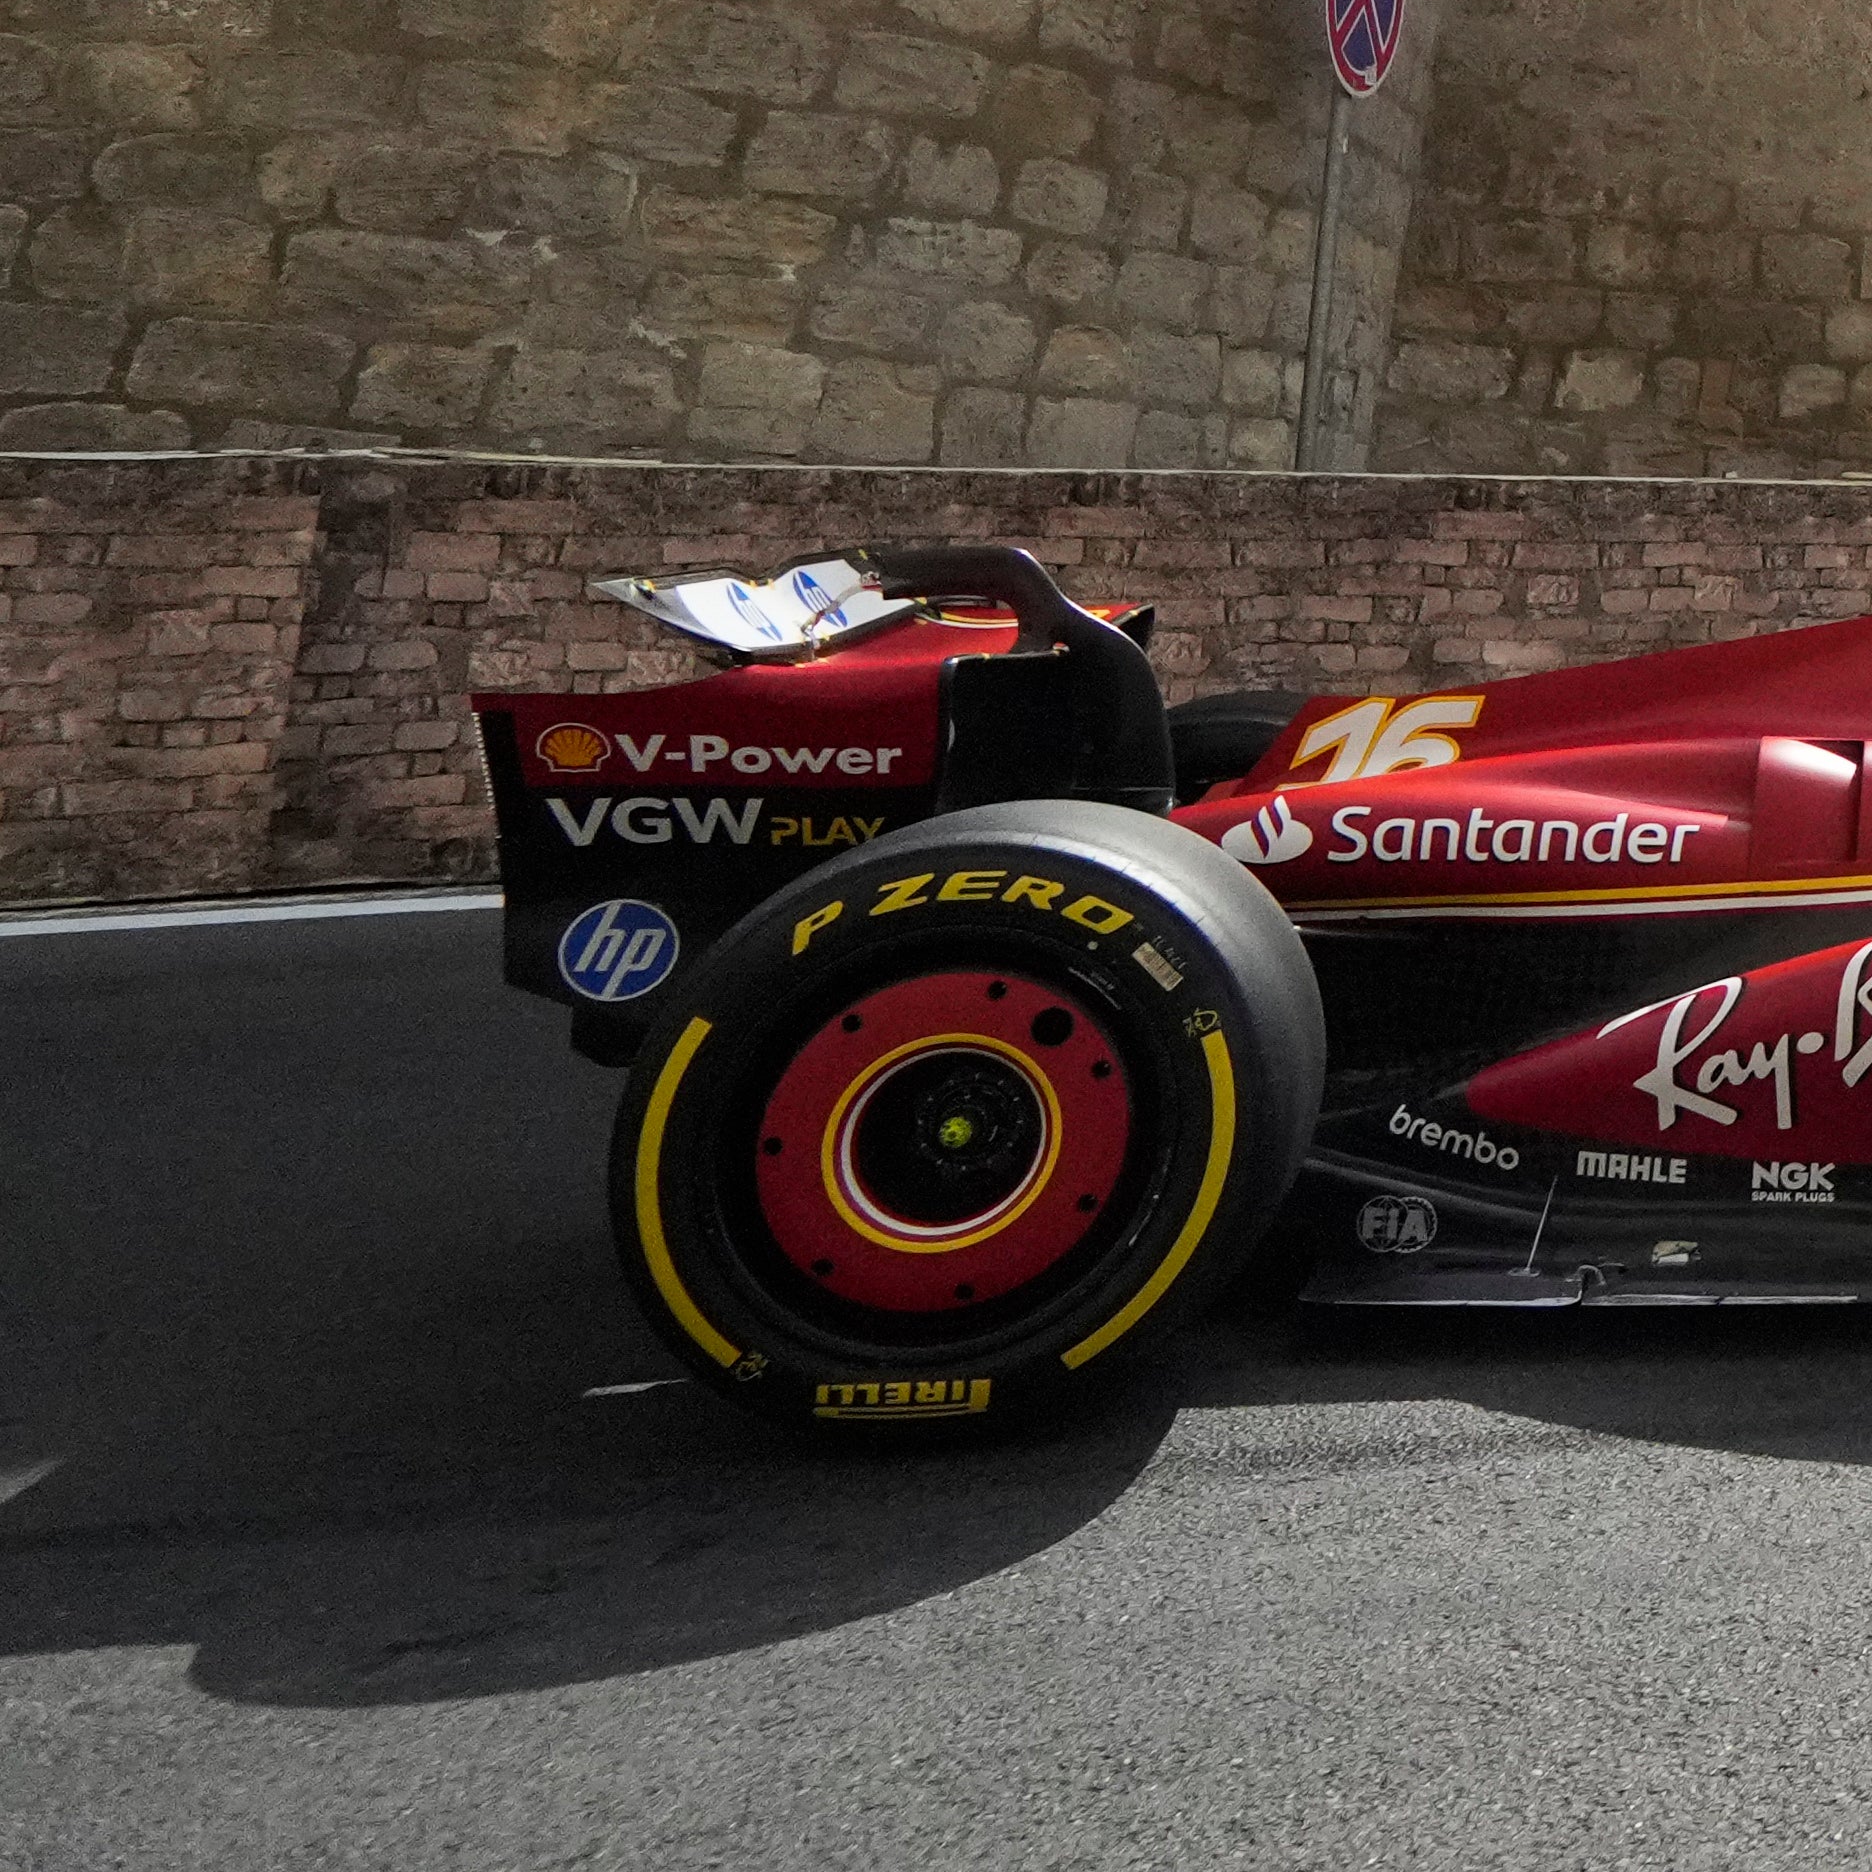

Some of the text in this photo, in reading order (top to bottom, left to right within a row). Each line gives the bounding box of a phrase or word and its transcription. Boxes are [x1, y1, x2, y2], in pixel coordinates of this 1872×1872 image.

[614, 733, 903, 776] V-Power
[1278, 695, 1485, 791] 16
[545, 796, 886, 847] VGW PLAY
[1327, 806, 1700, 865] Santander
[792, 870, 1135, 956] P ZERO
[571, 901, 664, 999] hp
[1389, 1104, 1520, 1171] brembo
[1576, 1150, 1688, 1184] MAHLE
[1751, 1160, 1836, 1191] NGK
[1751, 1190, 1836, 1203] SPARK PLUGS
[1361, 1205, 1429, 1243] FIA
[813, 1378, 992, 1418] PIRELLI
